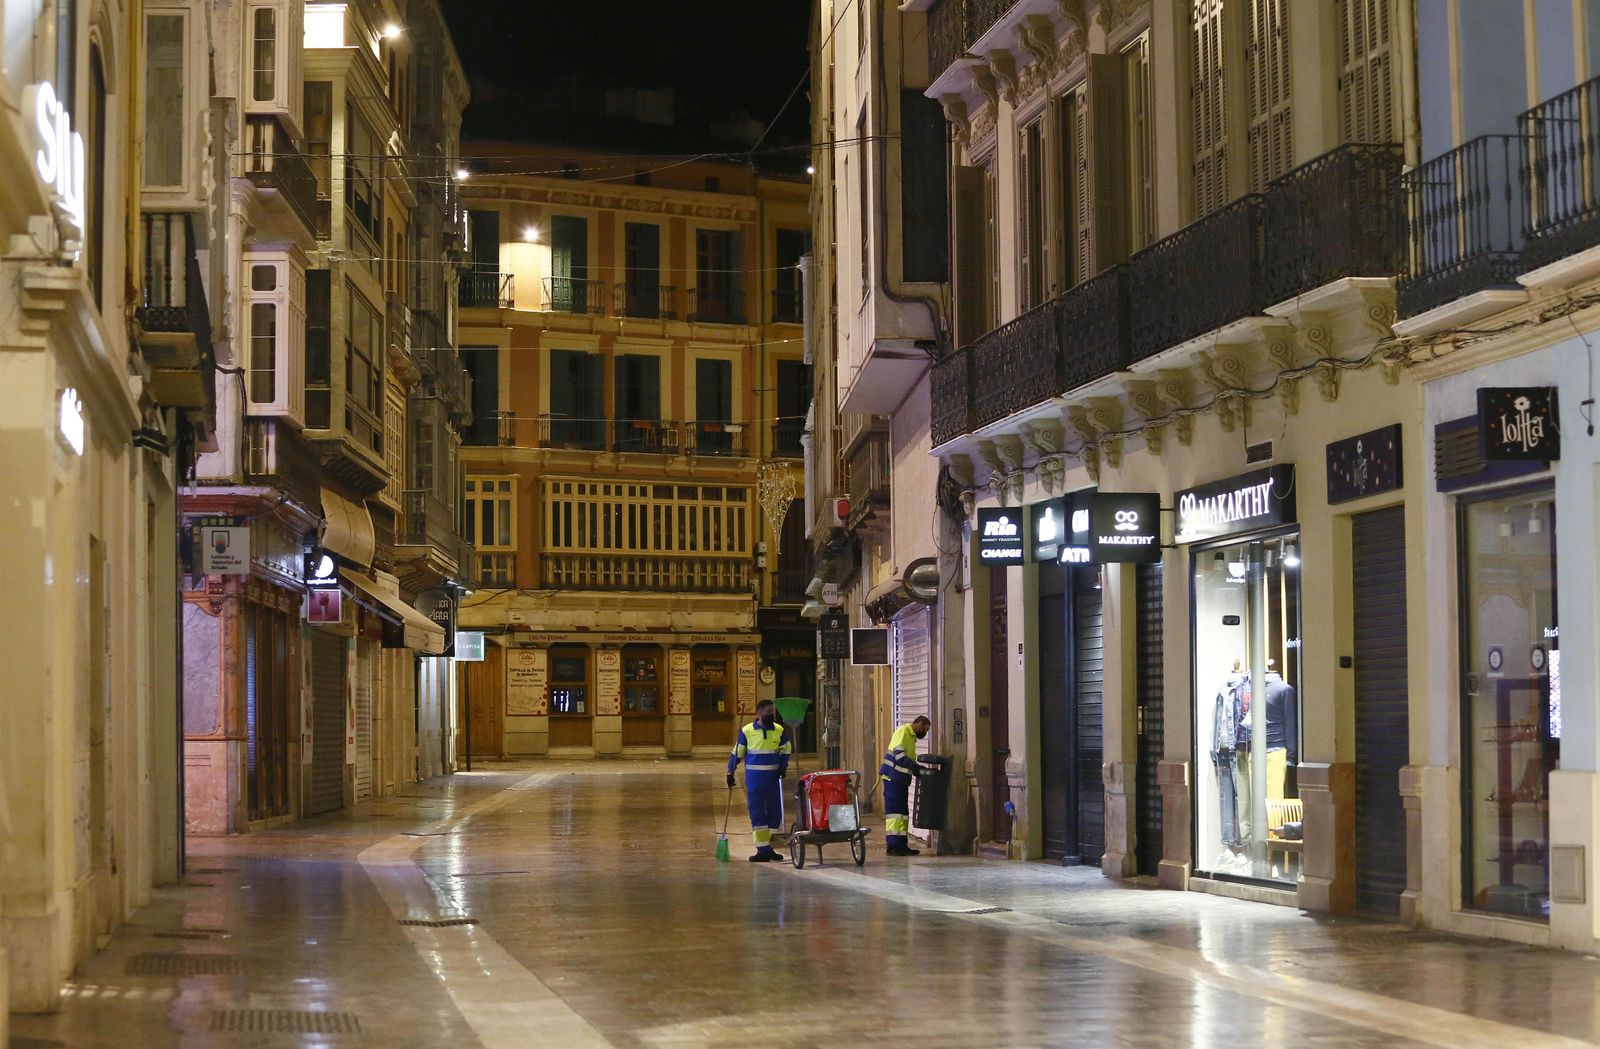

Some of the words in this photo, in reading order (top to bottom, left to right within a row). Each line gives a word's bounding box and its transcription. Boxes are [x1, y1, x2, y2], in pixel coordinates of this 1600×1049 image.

[1198, 483, 1272, 526] MAKARTHY
[1098, 535, 1153, 545] MAKARTHY
[981, 548, 1022, 558] CHANGE
